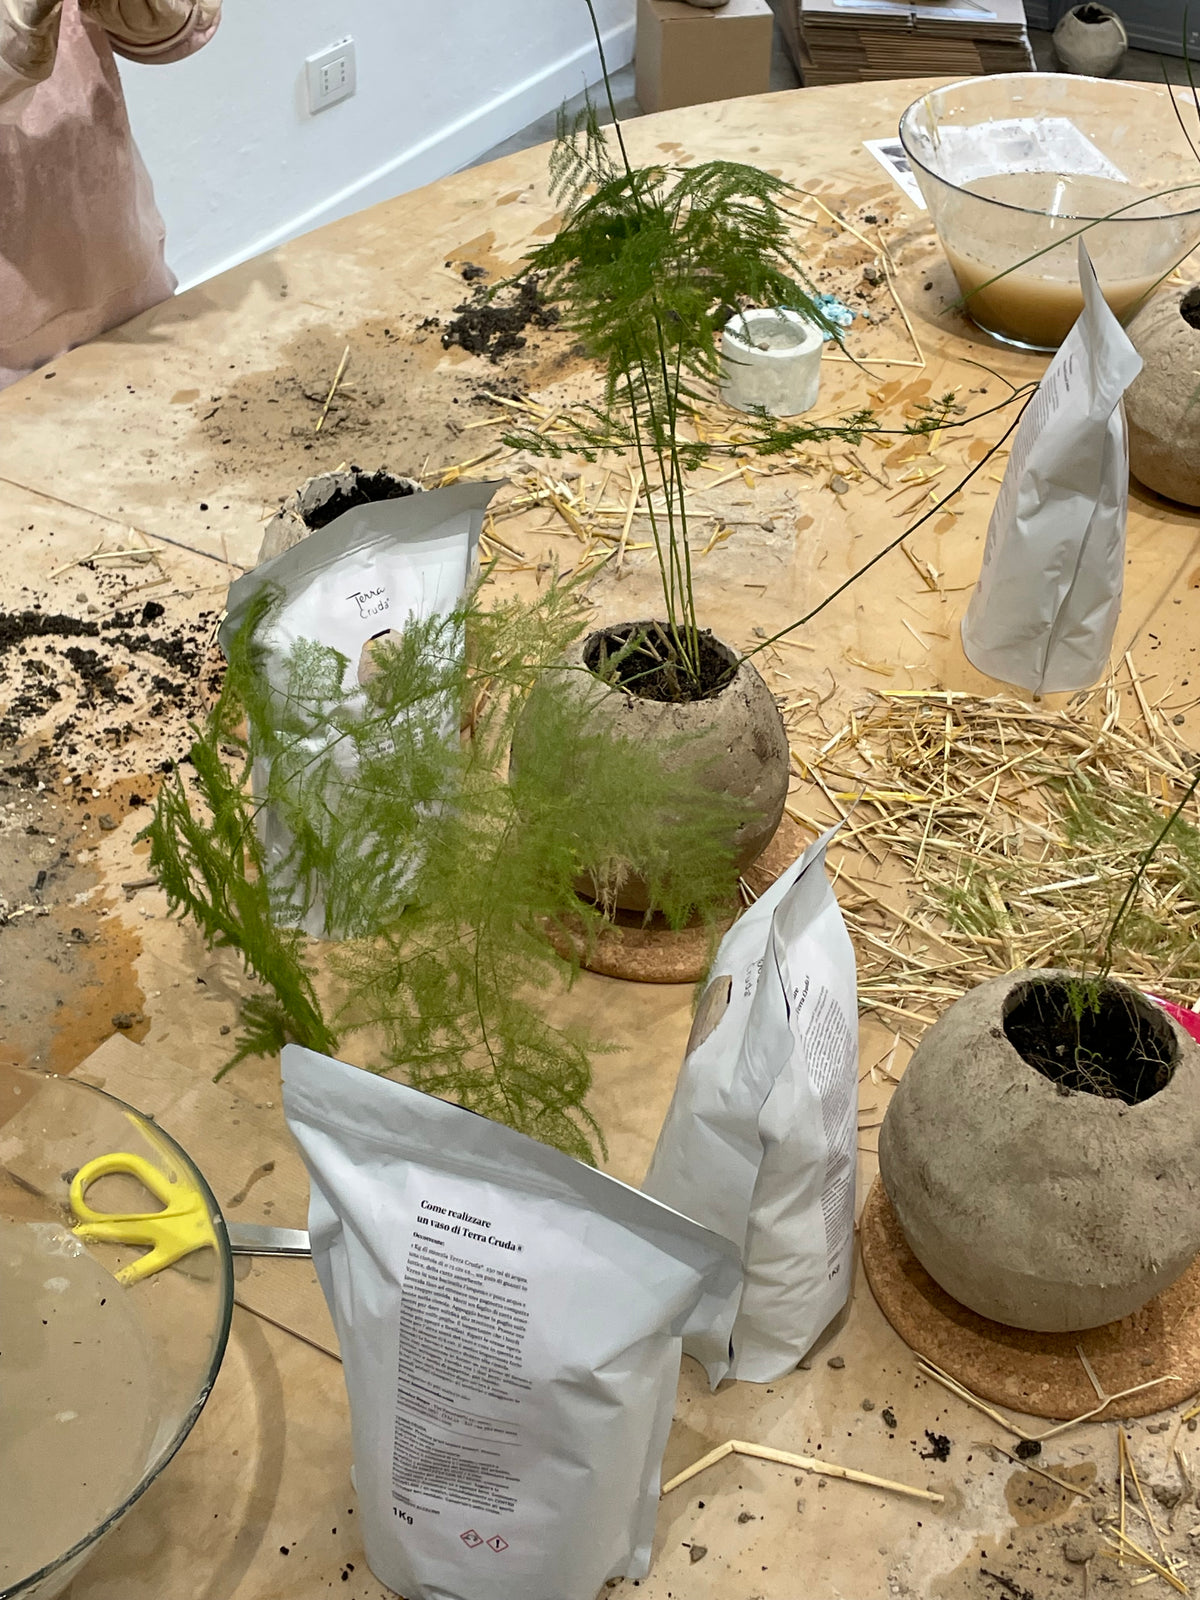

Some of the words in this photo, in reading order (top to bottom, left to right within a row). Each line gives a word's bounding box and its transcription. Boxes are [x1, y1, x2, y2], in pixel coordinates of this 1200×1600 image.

[345, 587, 385, 611] Terra
[421, 1200, 447, 1215] Come
[448, 1210, 492, 1229] realizzare
[417, 1216, 429, 1226] un
[431, 1219, 451, 1231] vaso
[451, 1224, 461, 1235] di
[462, 1227, 487, 1243] Terra
